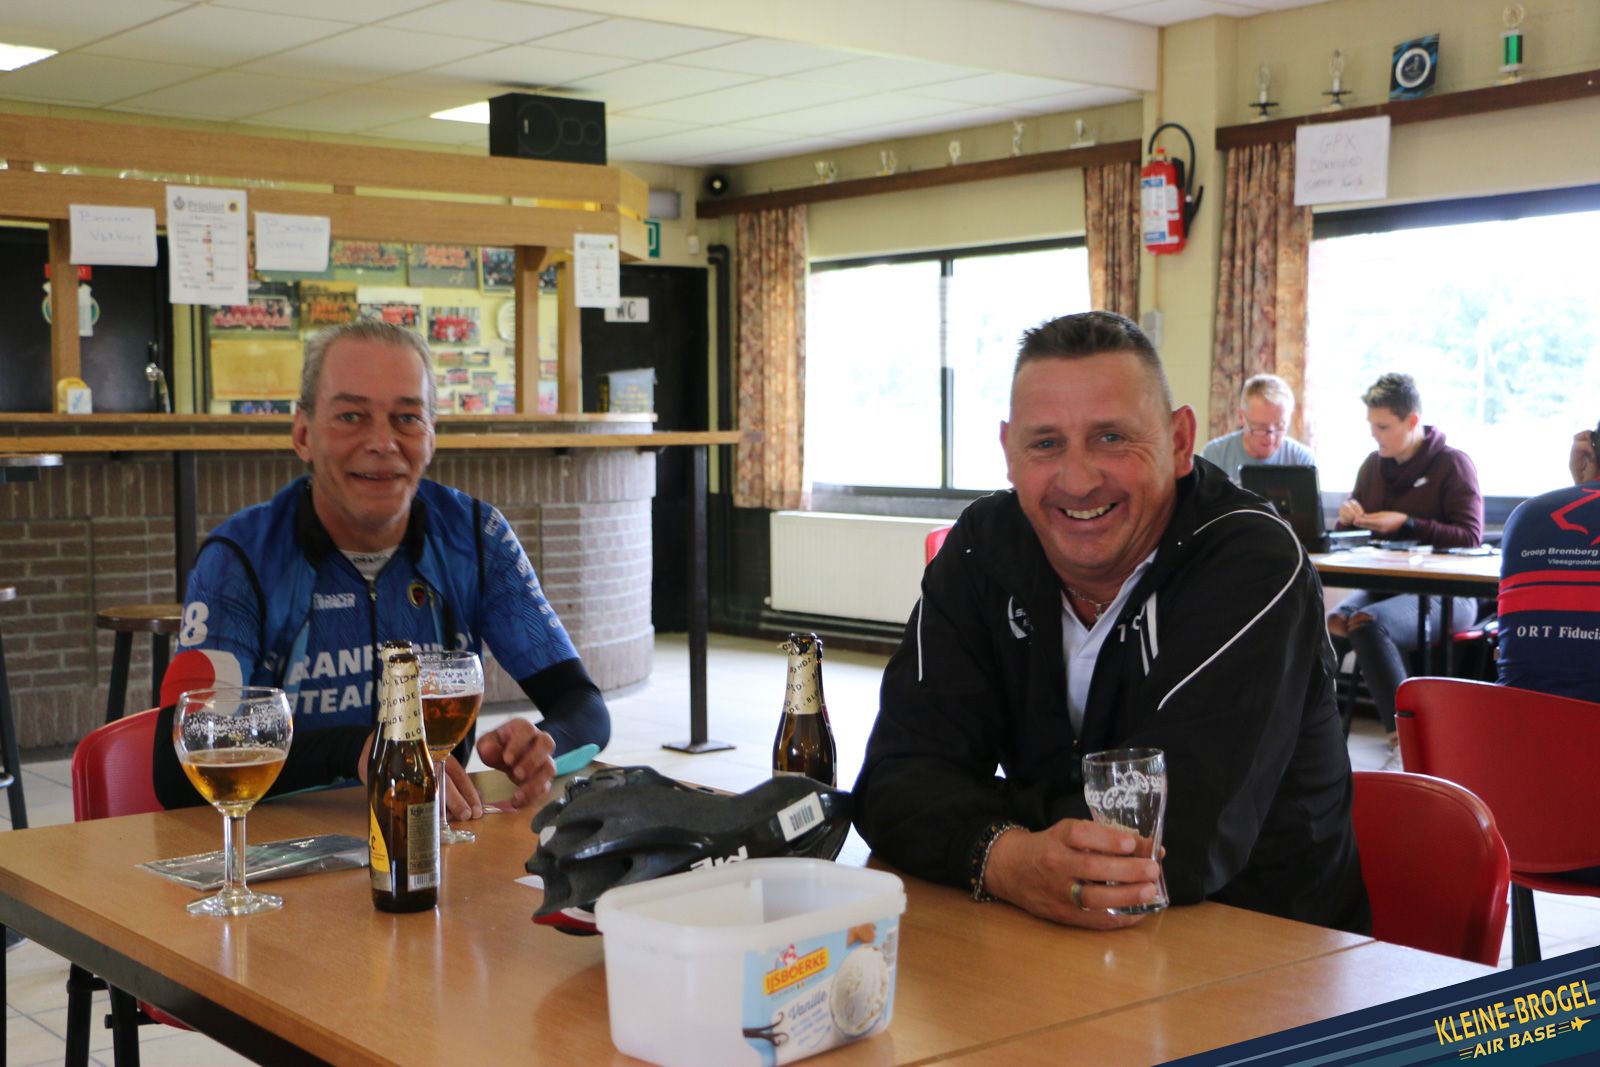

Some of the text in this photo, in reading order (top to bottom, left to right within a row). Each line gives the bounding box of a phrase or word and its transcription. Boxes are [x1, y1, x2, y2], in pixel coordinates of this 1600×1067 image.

[615, 300, 637, 320] WC
[1520, 547, 1599, 557] Groep Bremberg
